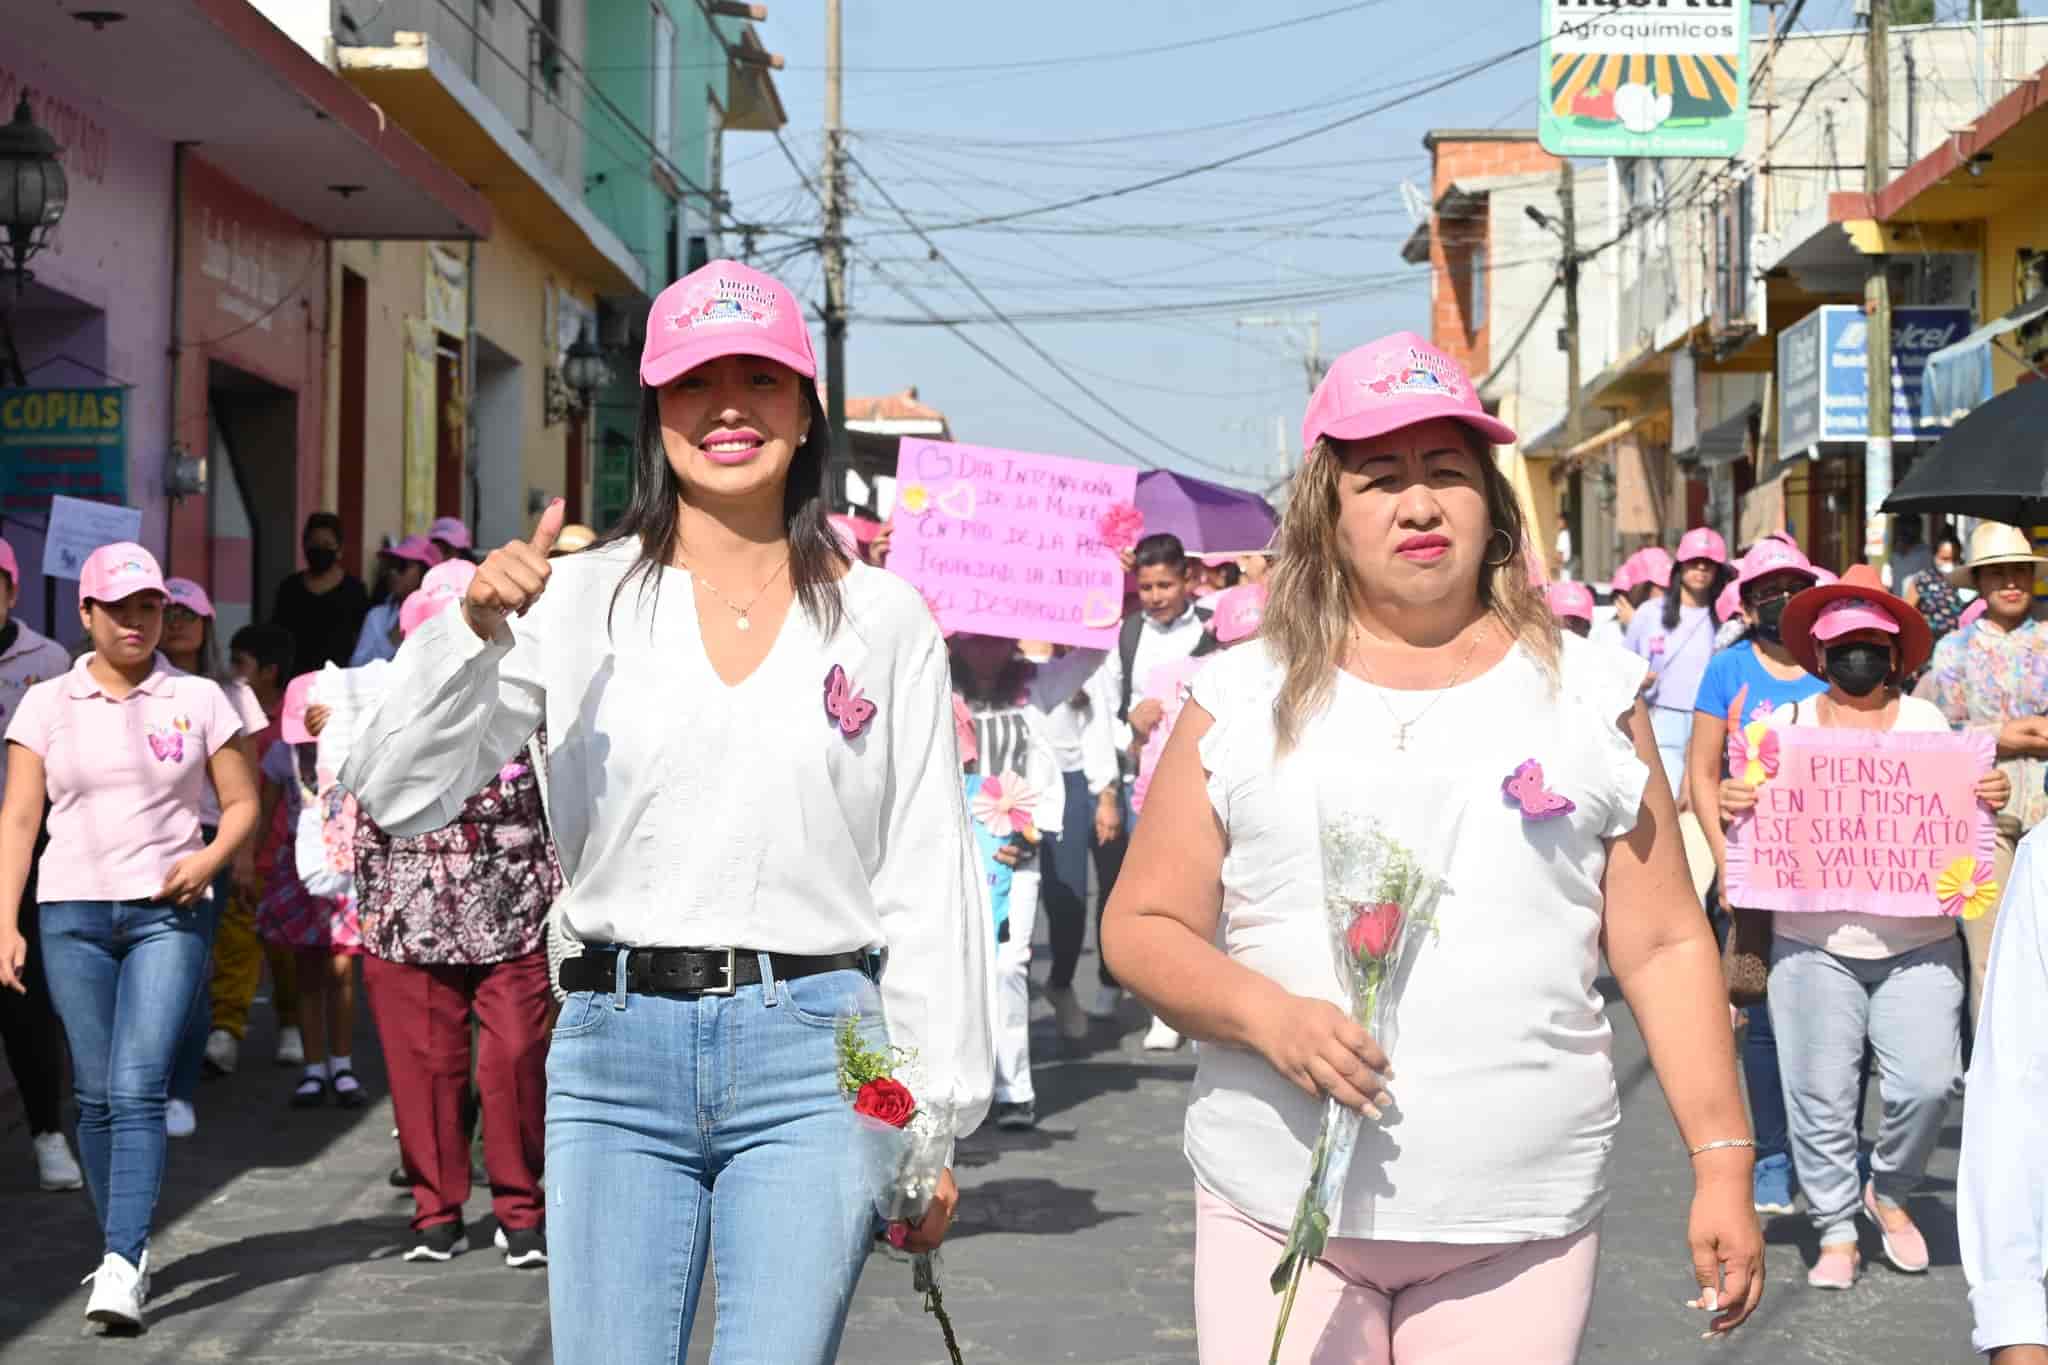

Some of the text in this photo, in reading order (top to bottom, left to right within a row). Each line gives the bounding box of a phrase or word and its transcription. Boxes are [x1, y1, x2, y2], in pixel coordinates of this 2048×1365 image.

[1559, 21, 1733, 38] Agroquímicos
[1889, 321, 1957, 350] elcel
[3, 391, 119, 429] COPIAS
[1810, 755, 1911, 786] PIENSA
[1770, 788, 1804, 814] EN
[1753, 814, 1799, 844] ESE
[1875, 818, 1902, 844] EL
[1913, 819, 1969, 845] ACTO
[1753, 847, 1943, 869] MAS VALIENTE
[1776, 870, 1931, 894] DE TU VIDA
